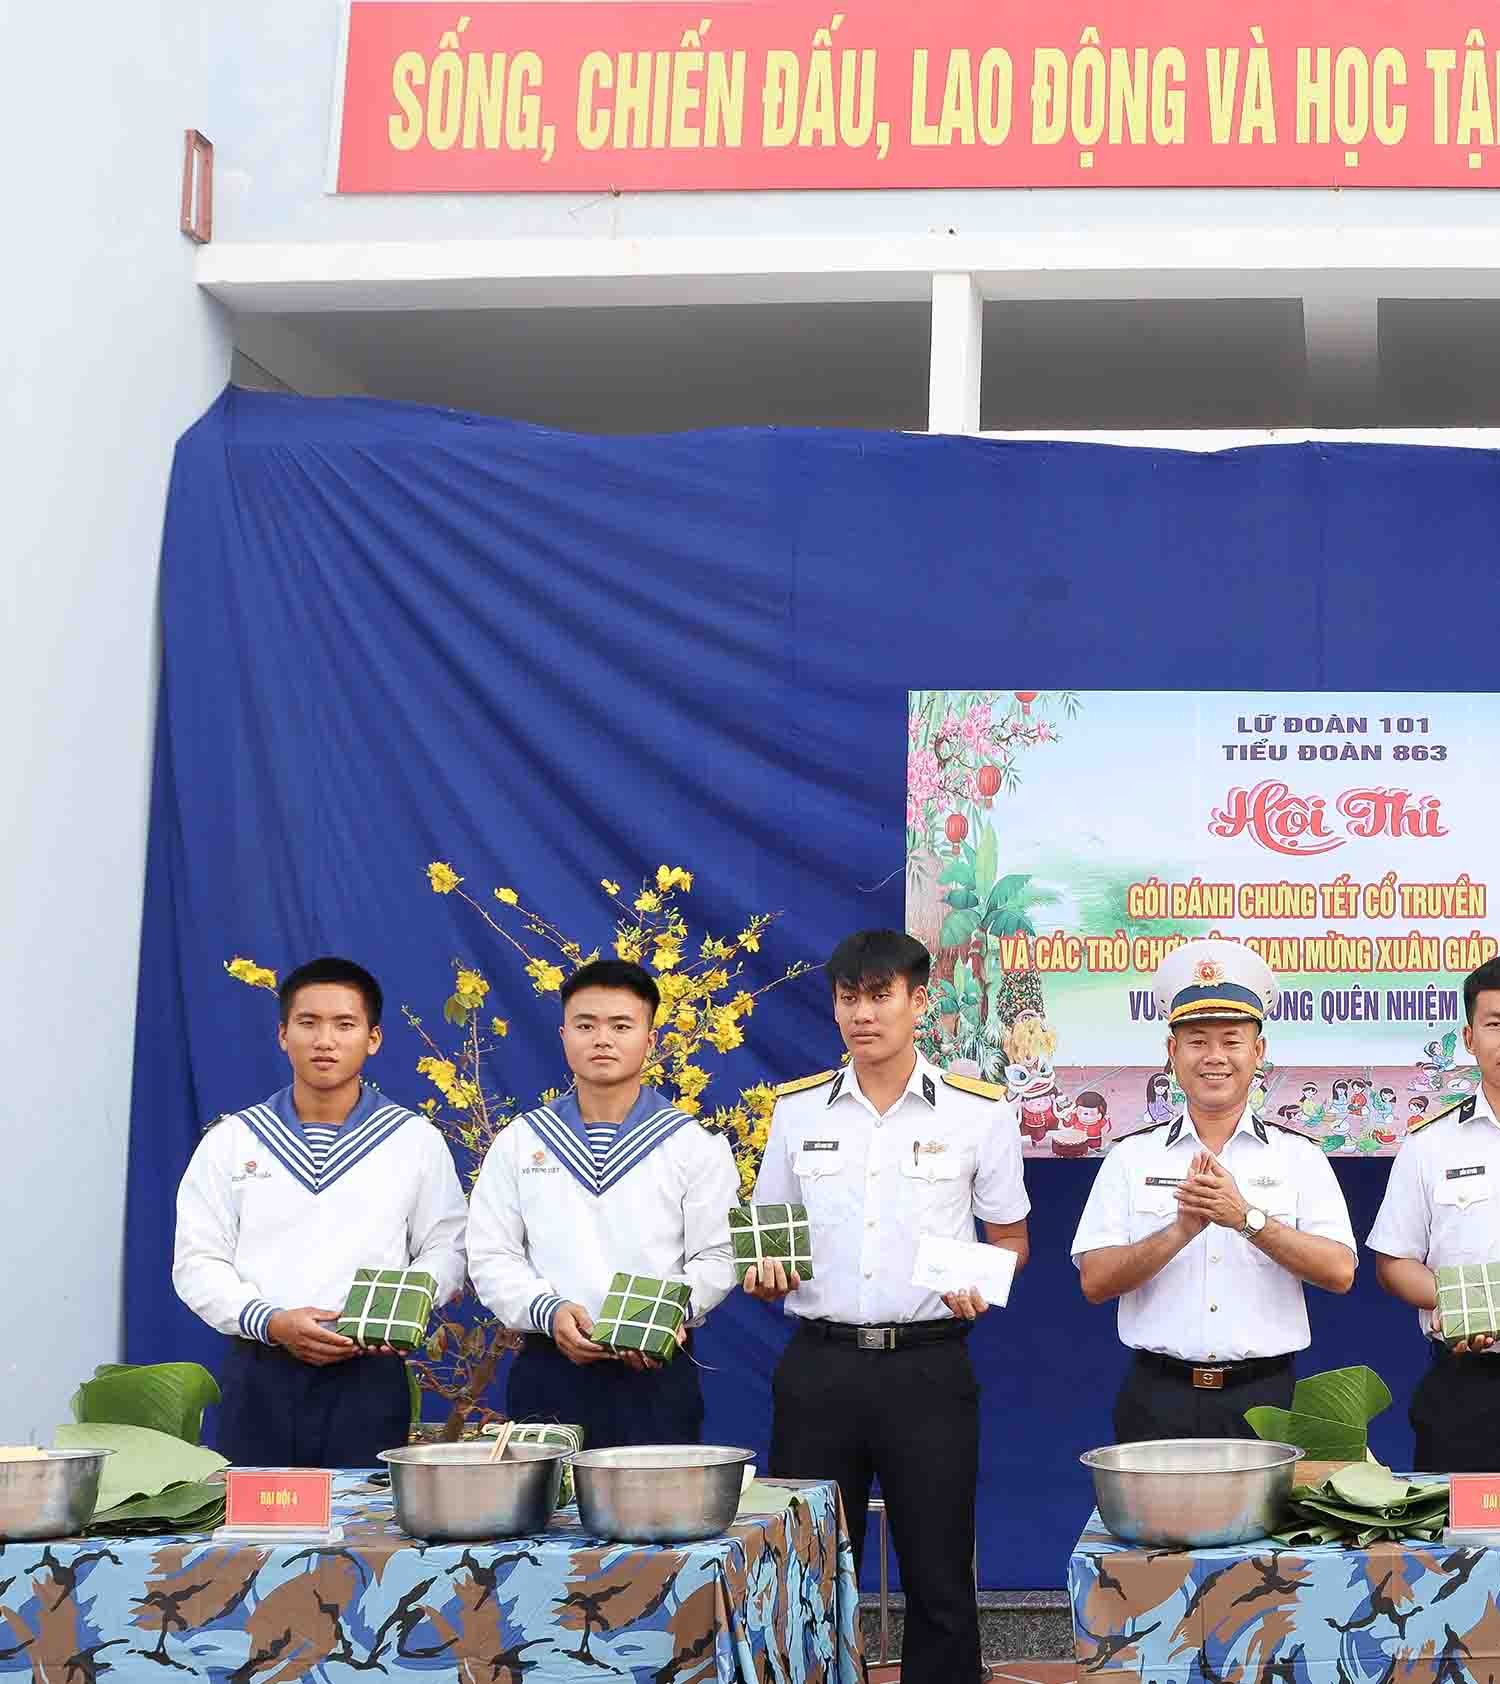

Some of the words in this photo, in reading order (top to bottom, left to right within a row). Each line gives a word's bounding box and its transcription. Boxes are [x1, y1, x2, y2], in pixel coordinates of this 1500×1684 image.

[388, 15, 556, 161] SỐNG,
[576, 18, 747, 150] CHIẾN
[761, 15, 890, 160] ĐẤU,
[910, 47, 1013, 146] LAO
[1030, 26, 1185, 168] ĐỘNG
[1206, 26, 1276, 146] VÀ
[1295, 47, 1409, 168] HỌC
[1237, 714, 1278, 734] LỮ
[1283, 714, 1368, 734] ĐOÀN
[1379, 717, 1430, 734] 101
[1222, 738, 1288, 761] TIỂU
[1297, 742, 1382, 761] ĐOÀN
[1392, 744, 1448, 761] 863
[1211, 780, 1346, 857] Hội
[1340, 788, 1449, 838] Thi
[1127, 877, 1169, 919] GÓI
[1170, 877, 1235, 919] BÁNH
[1238, 880, 1317, 919] CHƯNG
[1320, 874, 1361, 919] TẾT
[1362, 871, 1397, 919] CỔ
[1399, 874, 1487, 919] TRUYỀN
[1000, 930, 1030, 972] VÀ
[1034, 930, 1082, 973] CÁC
[1085, 930, 1130, 973] TRÒ
[1303, 931, 1373, 973] MỪNG
[1376, 931, 1441, 973] XUÂN
[1444, 931, 1498, 972] GIÁP
[1129, 991, 1164, 1022] VU
[1321, 984, 1379, 1026] QUÊN
[1386, 984, 1458, 1028] NHIỆM
